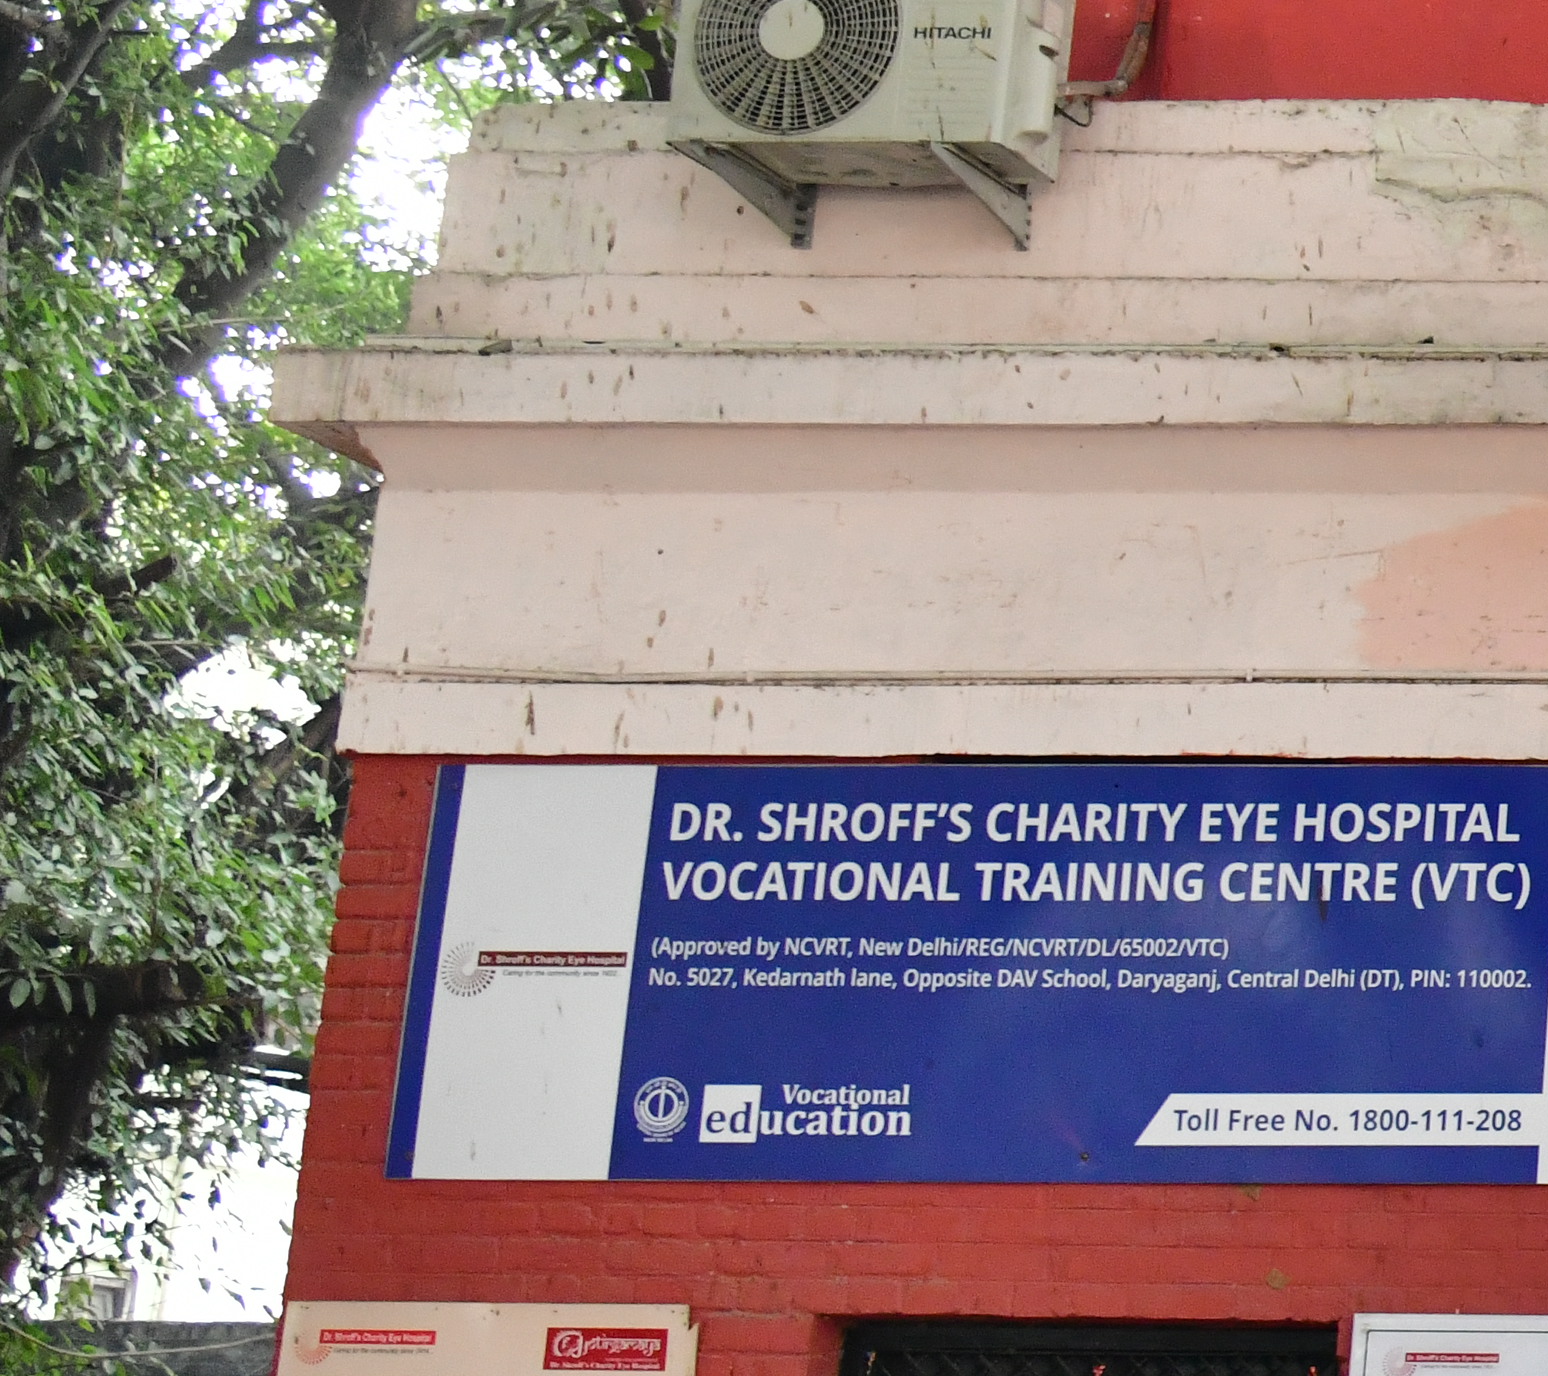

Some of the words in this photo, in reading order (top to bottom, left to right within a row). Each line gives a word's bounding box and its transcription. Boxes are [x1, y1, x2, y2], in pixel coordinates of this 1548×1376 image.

[914, 26, 991, 39] HITACHI
[670, 803, 742, 841] DR.
[987, 803, 1187, 842] CHARITY
[1200, 804, 1279, 841] EYE
[1294, 803, 1519, 842] HOSPITAL
[663, 862, 960, 901] VOCATIONAL
[975, 863, 1204, 901] TRAINING
[1220, 862, 1398, 901] CENTRE
[1412, 863, 1530, 909] (VTC)
[652, 937, 751, 960] (Approved
[756, 937, 780, 960] by
[785, 937, 853, 958] NCVRT,
[859, 938, 903, 956] New
[908, 937, 1228, 960] Delhi/REG/NCVRT/DL/65002/VTC)
[649, 968, 681, 986] No.
[687, 968, 737, 988] 5027,
[743, 968, 845, 986] Kedarnath
[851, 968, 897, 989] lane,
[904, 969, 992, 992] Opposite
[998, 969, 1038, 987] DAV
[1042, 969, 1111, 990] School,
[1118, 969, 1221, 993] Daryaganj,
[1228, 969, 1299, 987] Central
[1305, 969, 1355, 987] Delhi
[1360, 970, 1404, 991] (DT),
[1411, 970, 1450, 987] PIN:
[1458, 970, 1531, 987] 110002.
[782, 1084, 910, 1105] Vocational
[706, 1101, 911, 1136] education
[1174, 1109, 1218, 1131] Toll
[1229, 1110, 1284, 1131] Free
[1295, 1110, 1337, 1131] No.
[1350, 1110, 1521, 1131] 1800-111-208
